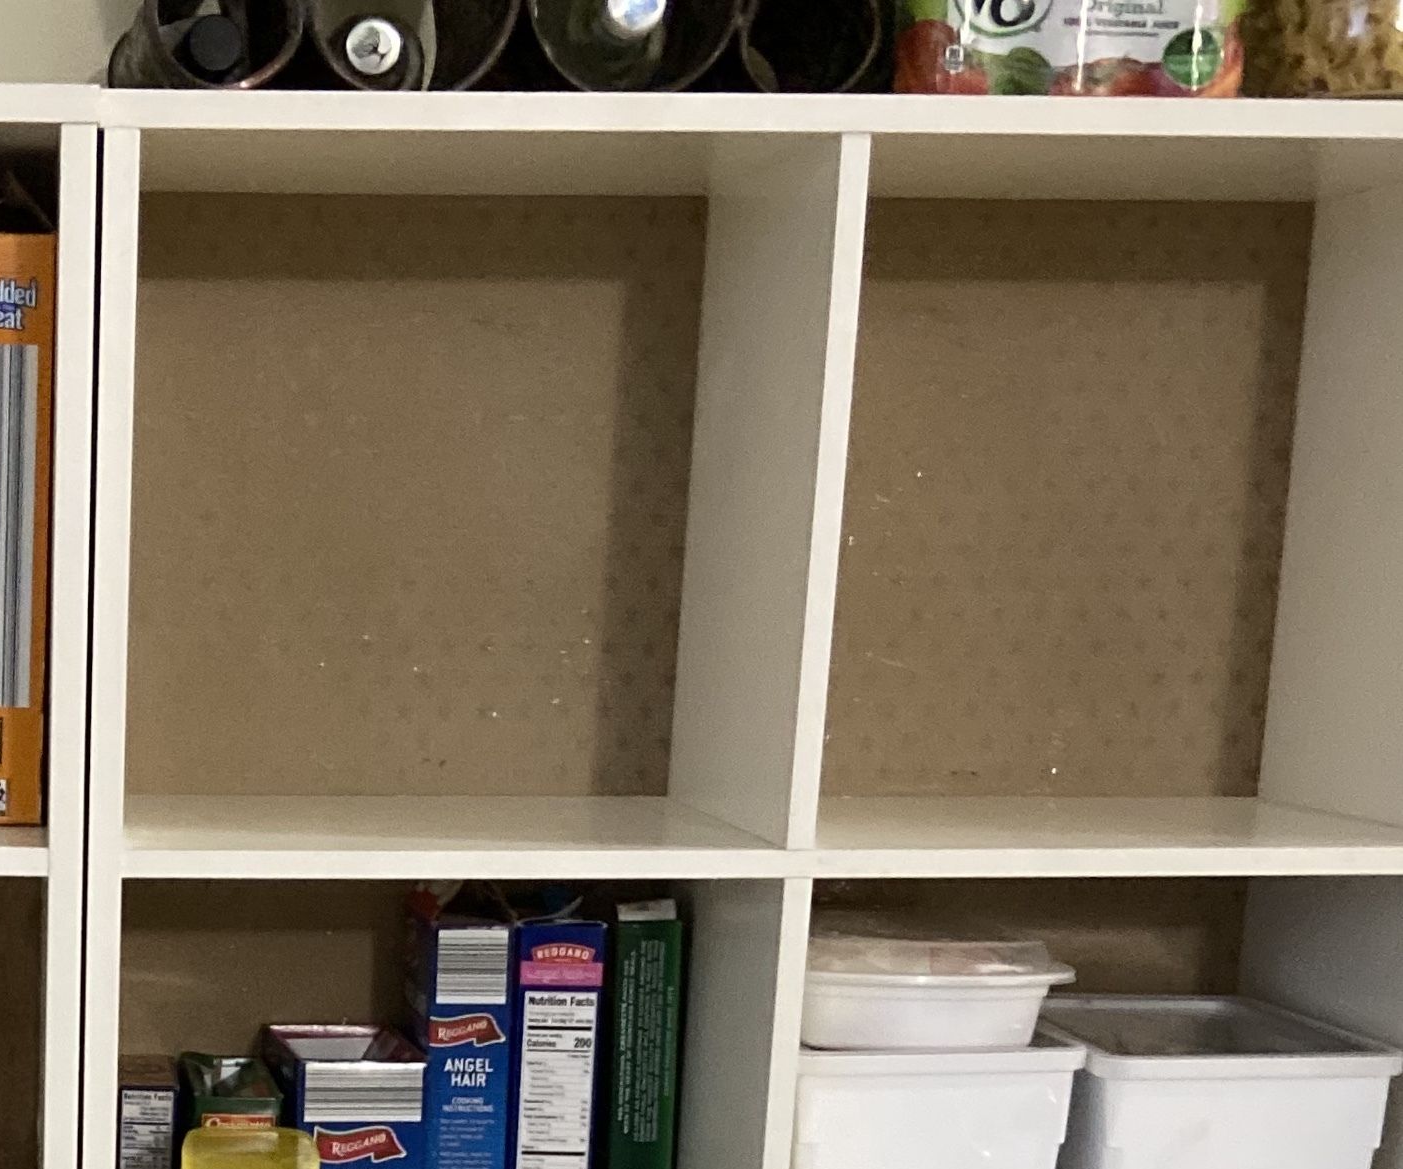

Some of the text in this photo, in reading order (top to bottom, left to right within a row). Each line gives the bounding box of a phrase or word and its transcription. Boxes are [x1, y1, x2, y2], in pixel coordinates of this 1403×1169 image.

[528, 996, 596, 1007] Nutrition Facts
[443, 1057, 494, 1073] ANGEL
[451, 1072, 487, 1088] HAIR
